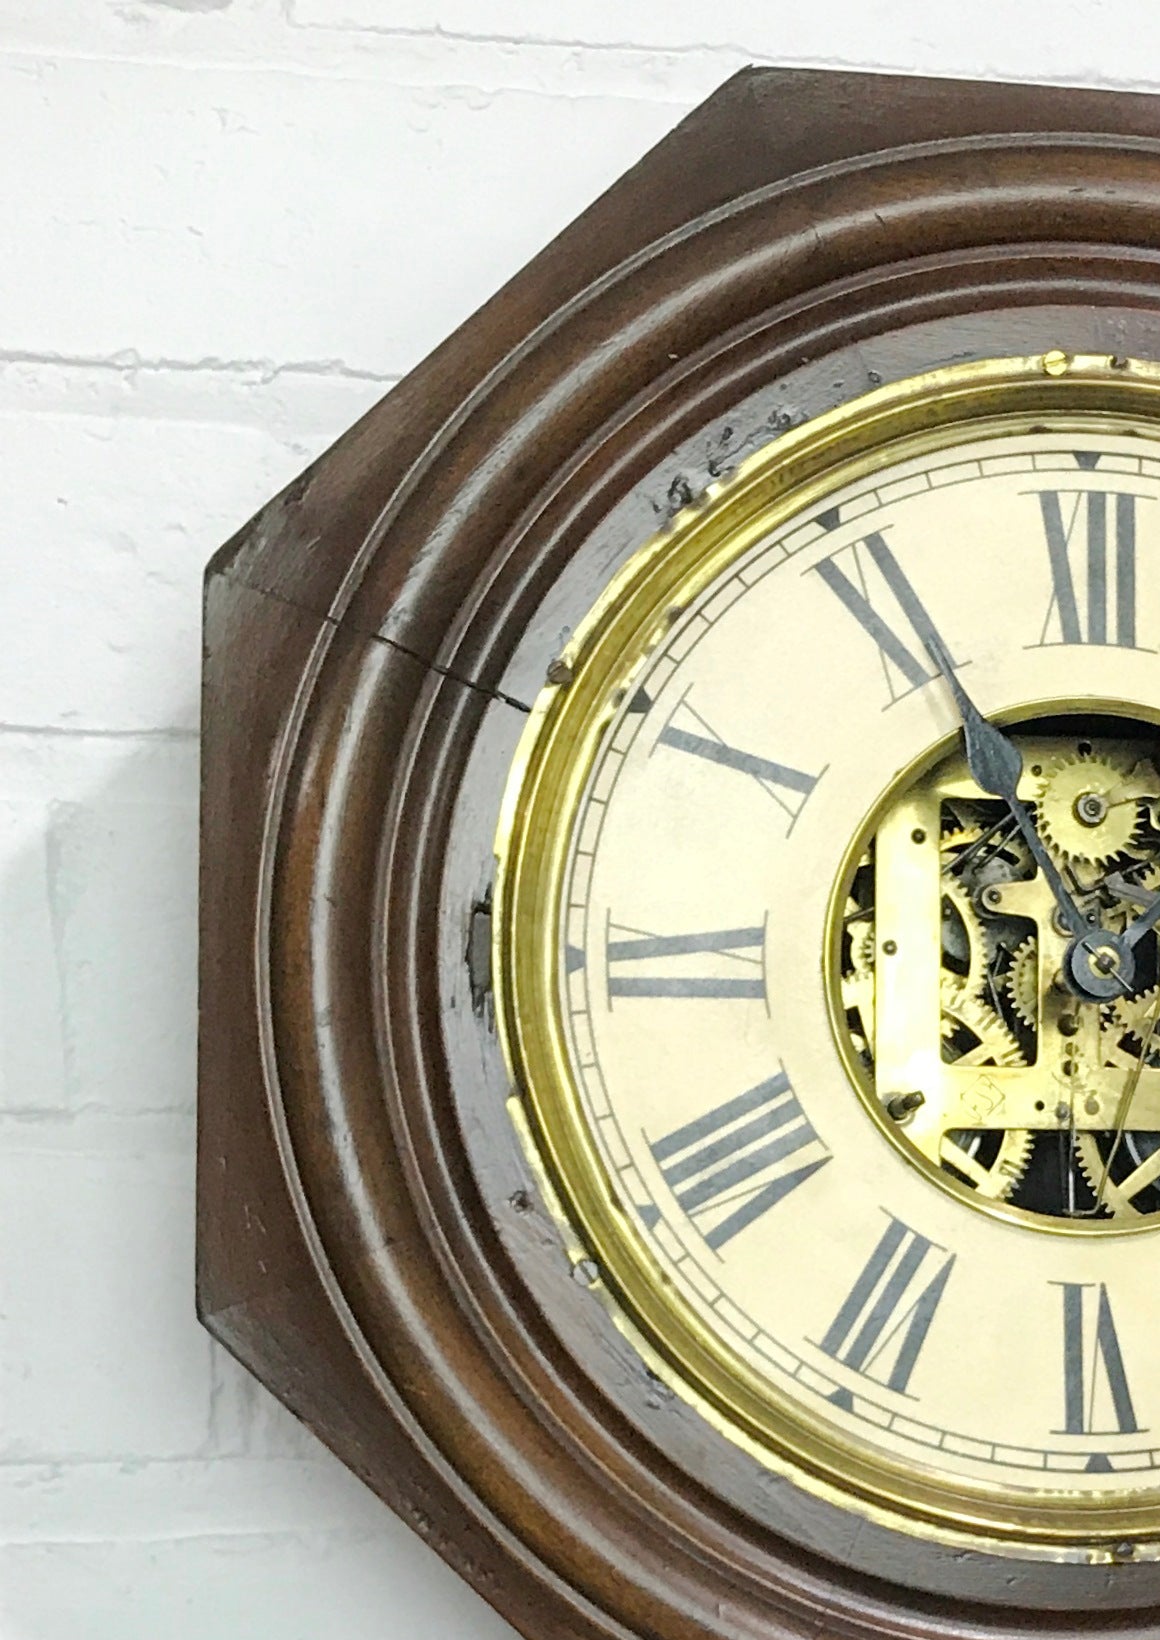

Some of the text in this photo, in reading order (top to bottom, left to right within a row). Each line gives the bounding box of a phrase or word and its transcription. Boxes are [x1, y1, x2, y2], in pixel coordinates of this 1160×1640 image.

[801, 524, 974, 712] XI
[647, 684, 829, 838] X
[606, 908, 771, 1018] IX
[646, 1059, 831, 1262] VIII
[801, 1207, 955, 1396] VII
[1047, 1281, 1150, 1436] VI
